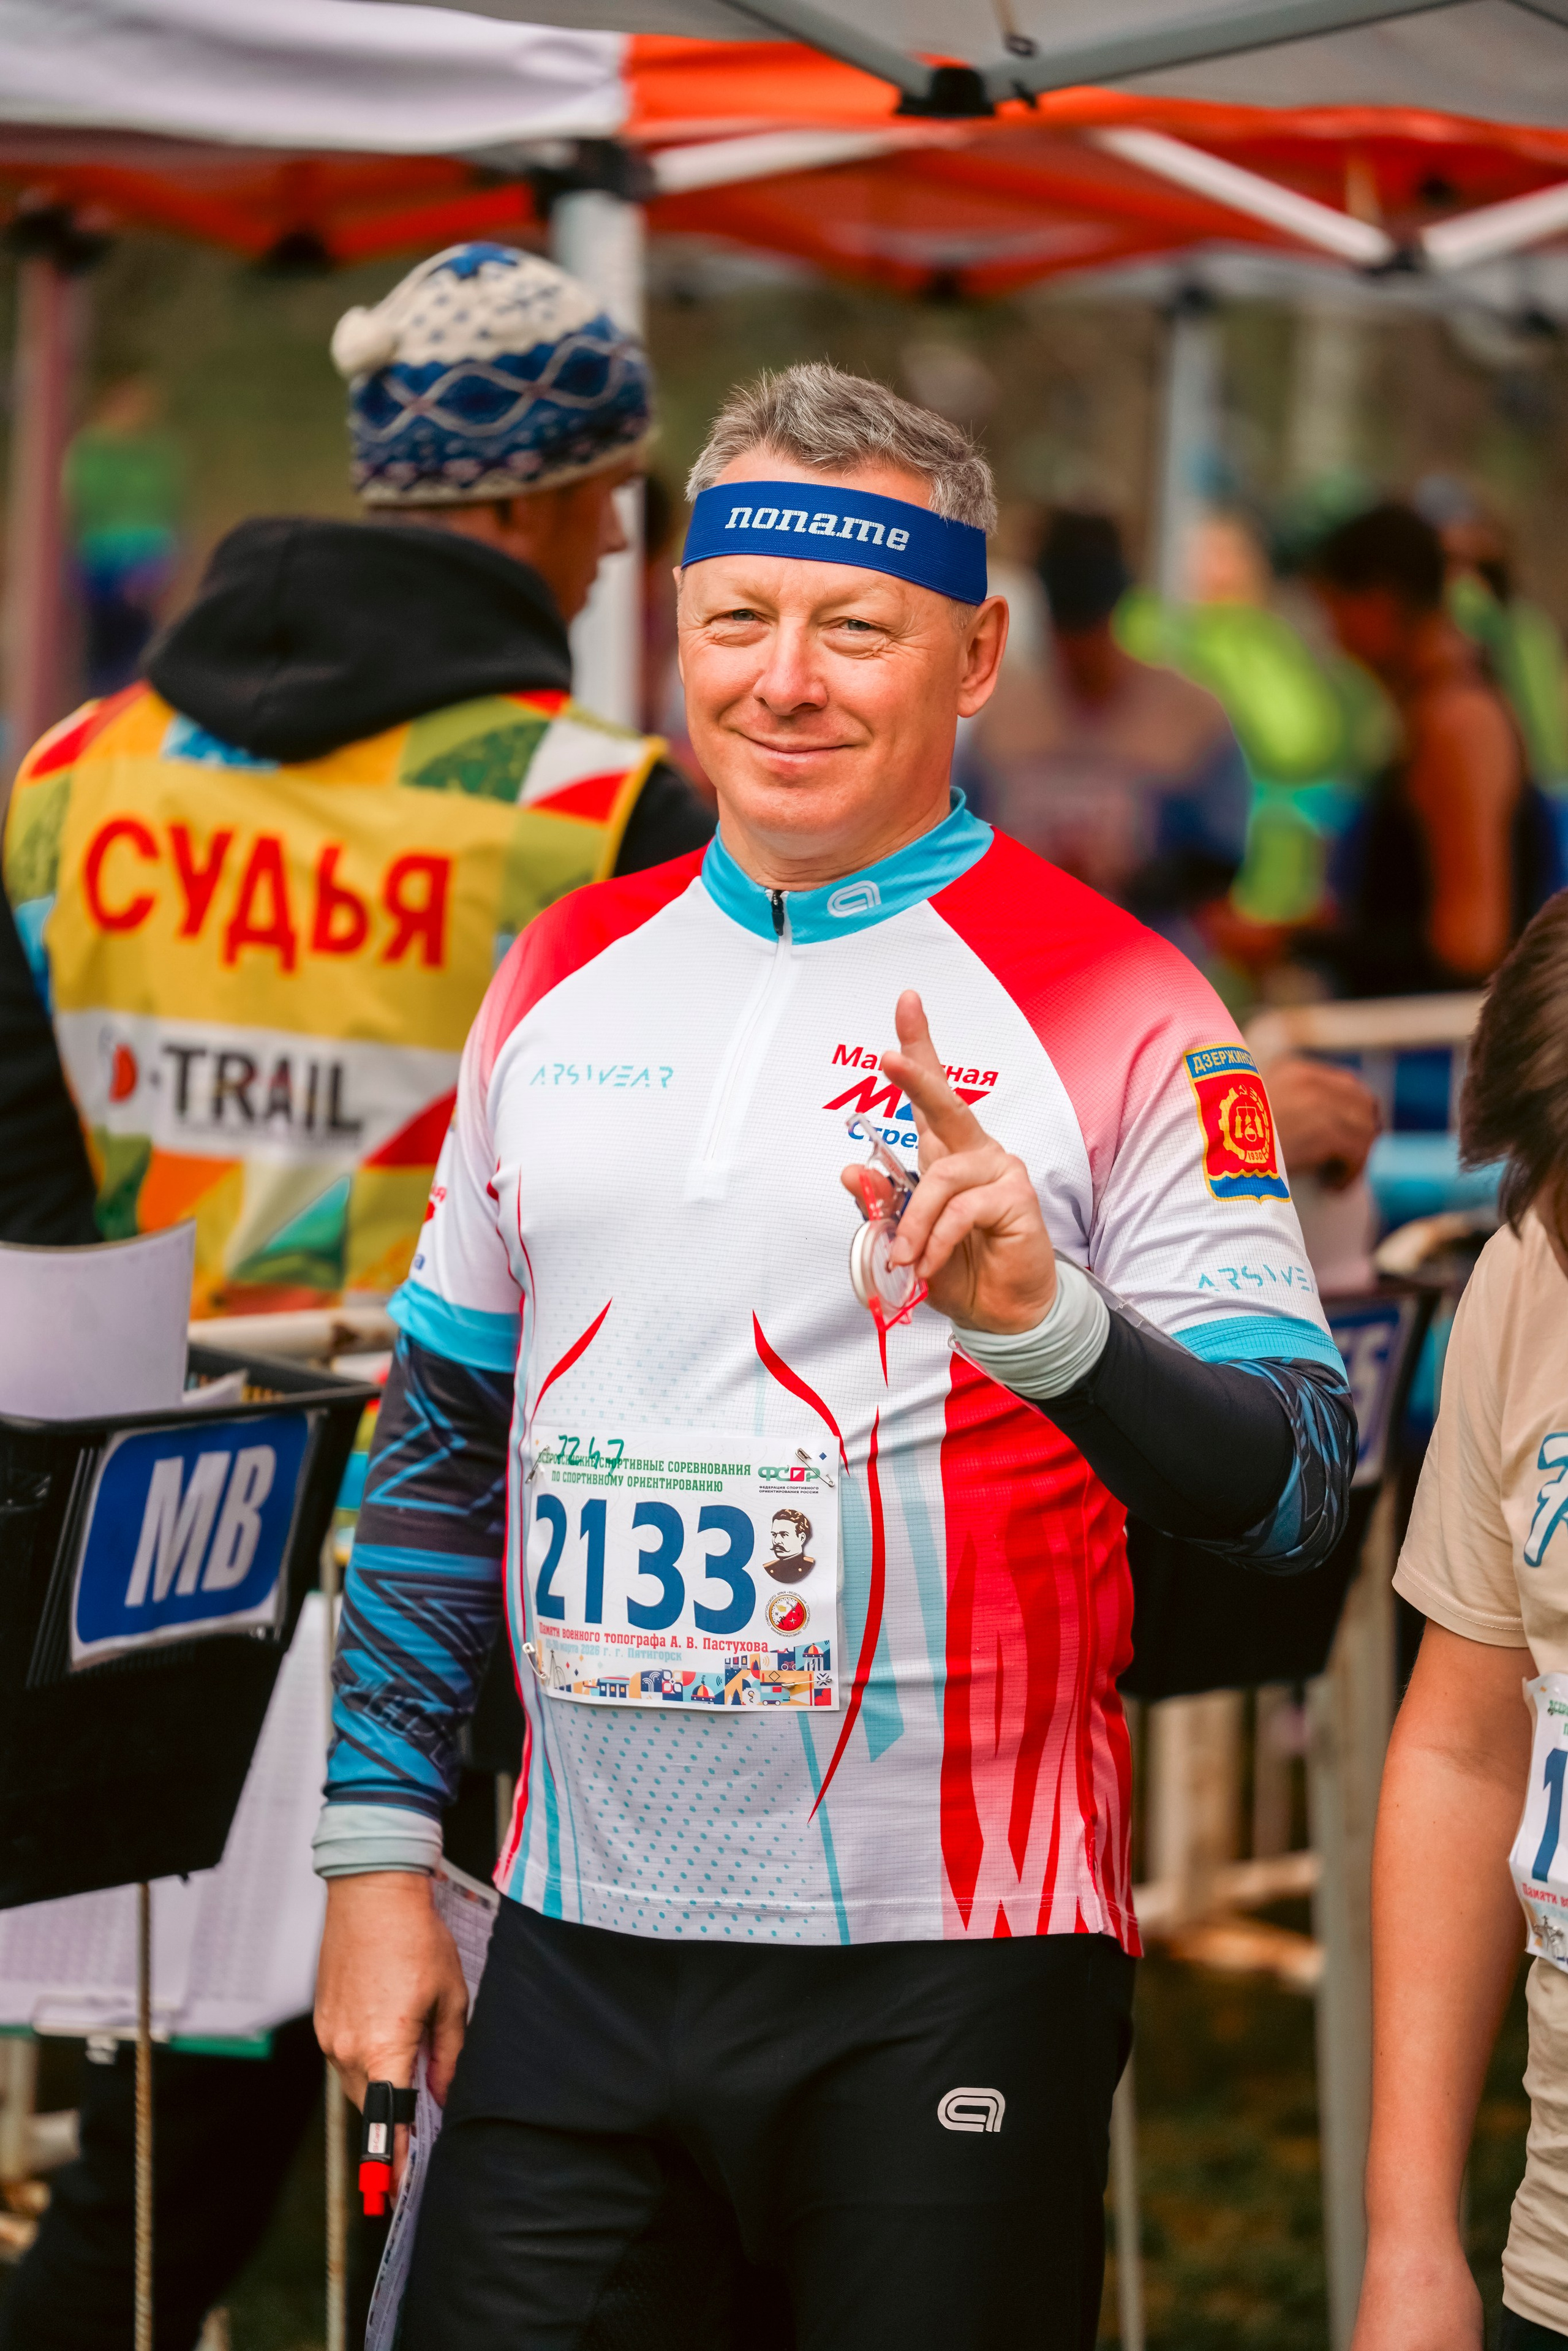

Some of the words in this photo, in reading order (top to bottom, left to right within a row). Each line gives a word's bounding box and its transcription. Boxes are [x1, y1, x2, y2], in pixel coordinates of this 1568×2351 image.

[725, 507, 910, 551] noname
[82, 817, 454, 974] СУДЬЯ
[832, 1044, 999, 1086] Маная
[1248, 1152, 1263, 1161] 1930
[552, 1470, 560, 1482] ПО
[562, 1471, 624, 1487] СПОРТИВНОМУ
[627, 1476, 723, 1493] ОРИЕНТИРОВАНИЮ
[668, 1460, 752, 1476] СОРЕВНОВАНИЯ
[535, 1493, 757, 1635] 2133
[539, 1622, 560, 1637] Памяти
[562, 1628, 600, 1643] военного
[604, 1632, 666, 1650] топографа
[670, 1636, 681, 1648] А.
[687, 1636, 698, 1649] В.
[703, 1637, 769, 1655] Пастухова
[581, 1644, 600, 1656] 2026
[627, 1648, 682, 1662] Пятигорск
